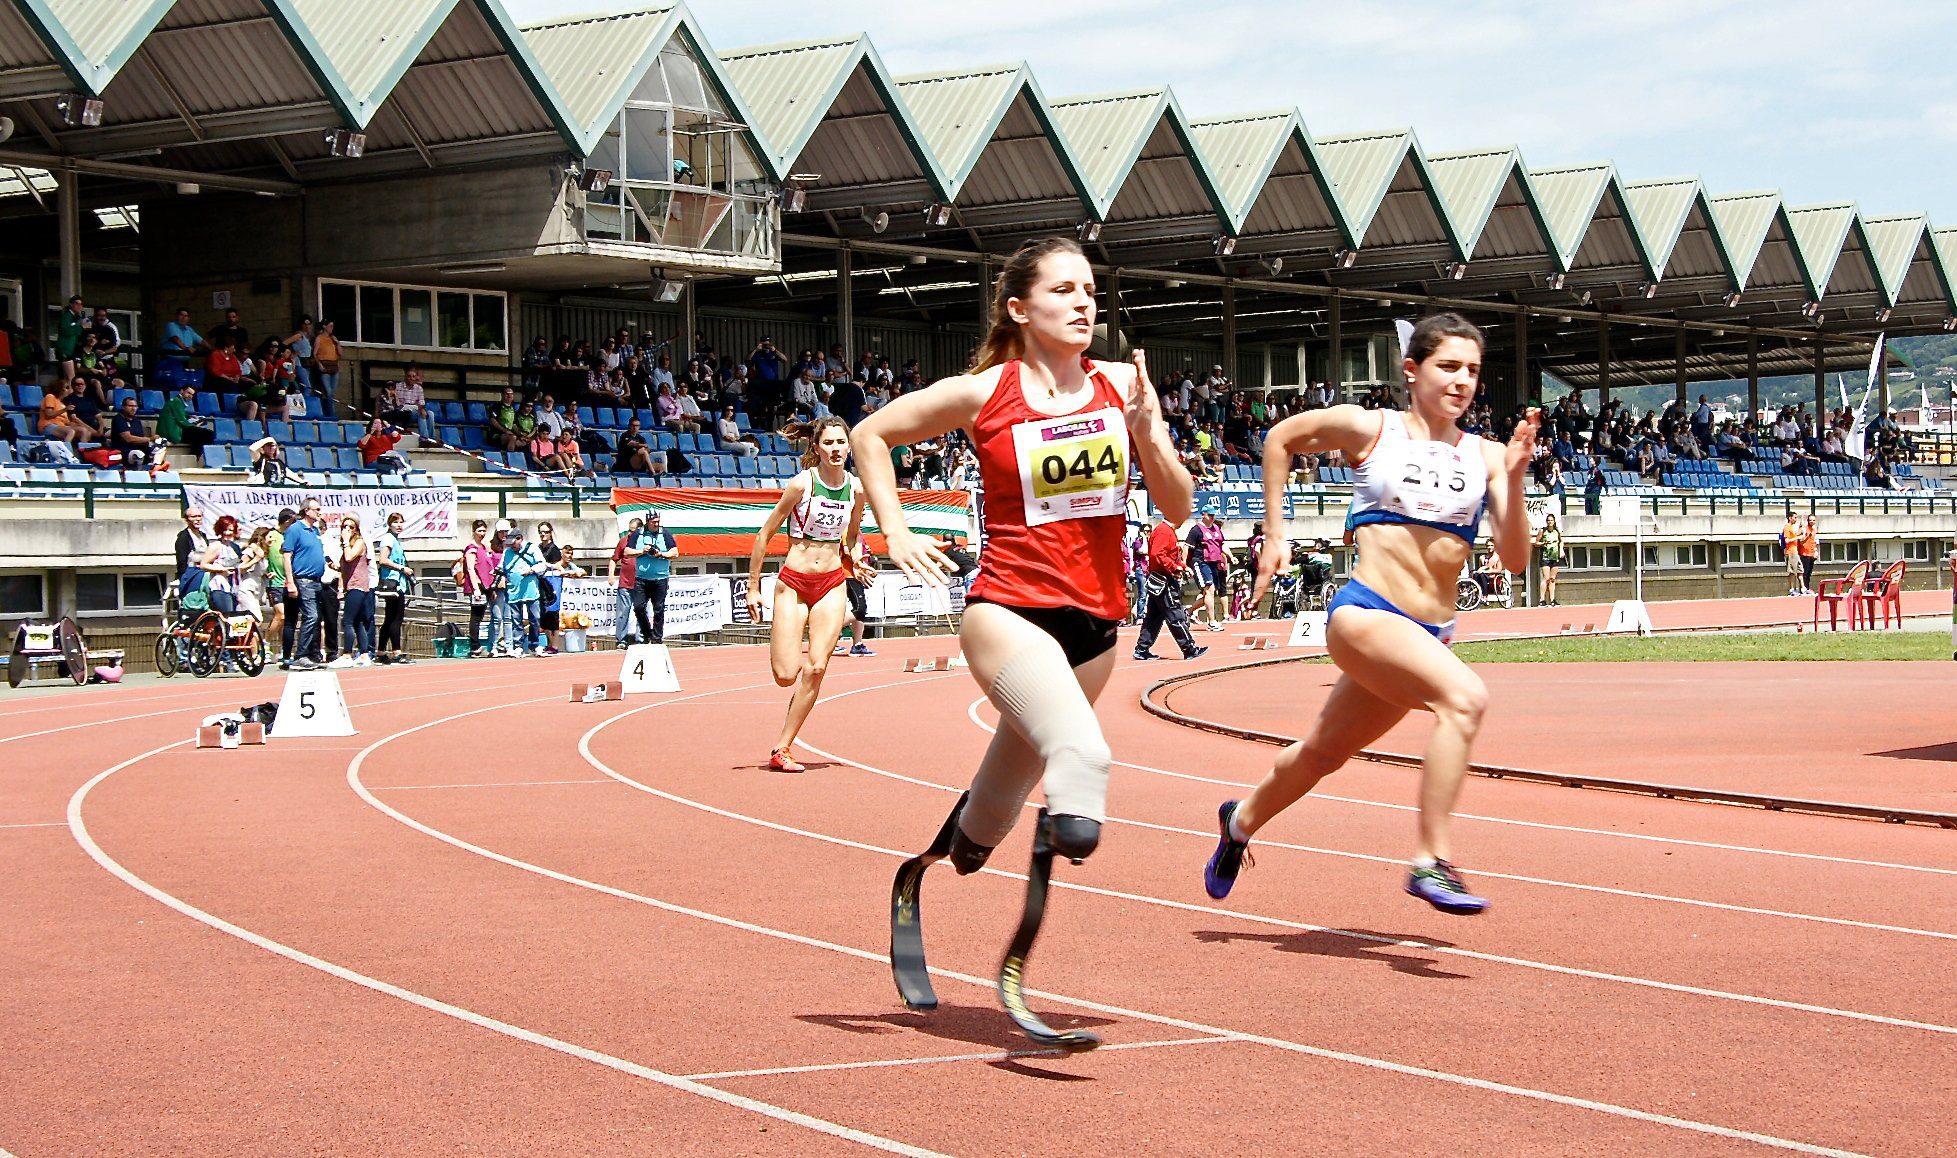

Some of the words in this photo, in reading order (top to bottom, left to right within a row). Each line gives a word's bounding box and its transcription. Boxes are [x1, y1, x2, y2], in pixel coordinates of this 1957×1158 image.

[1042, 444, 1118, 485] 044
[245, 491, 301, 506] ADAPTADO
[667, 587, 714, 598] ARATONES
[1620, 610, 1625, 623] 1
[1301, 622, 1311, 637] 2
[633, 659, 645, 680] 4
[300, 691, 316, 720] 5
